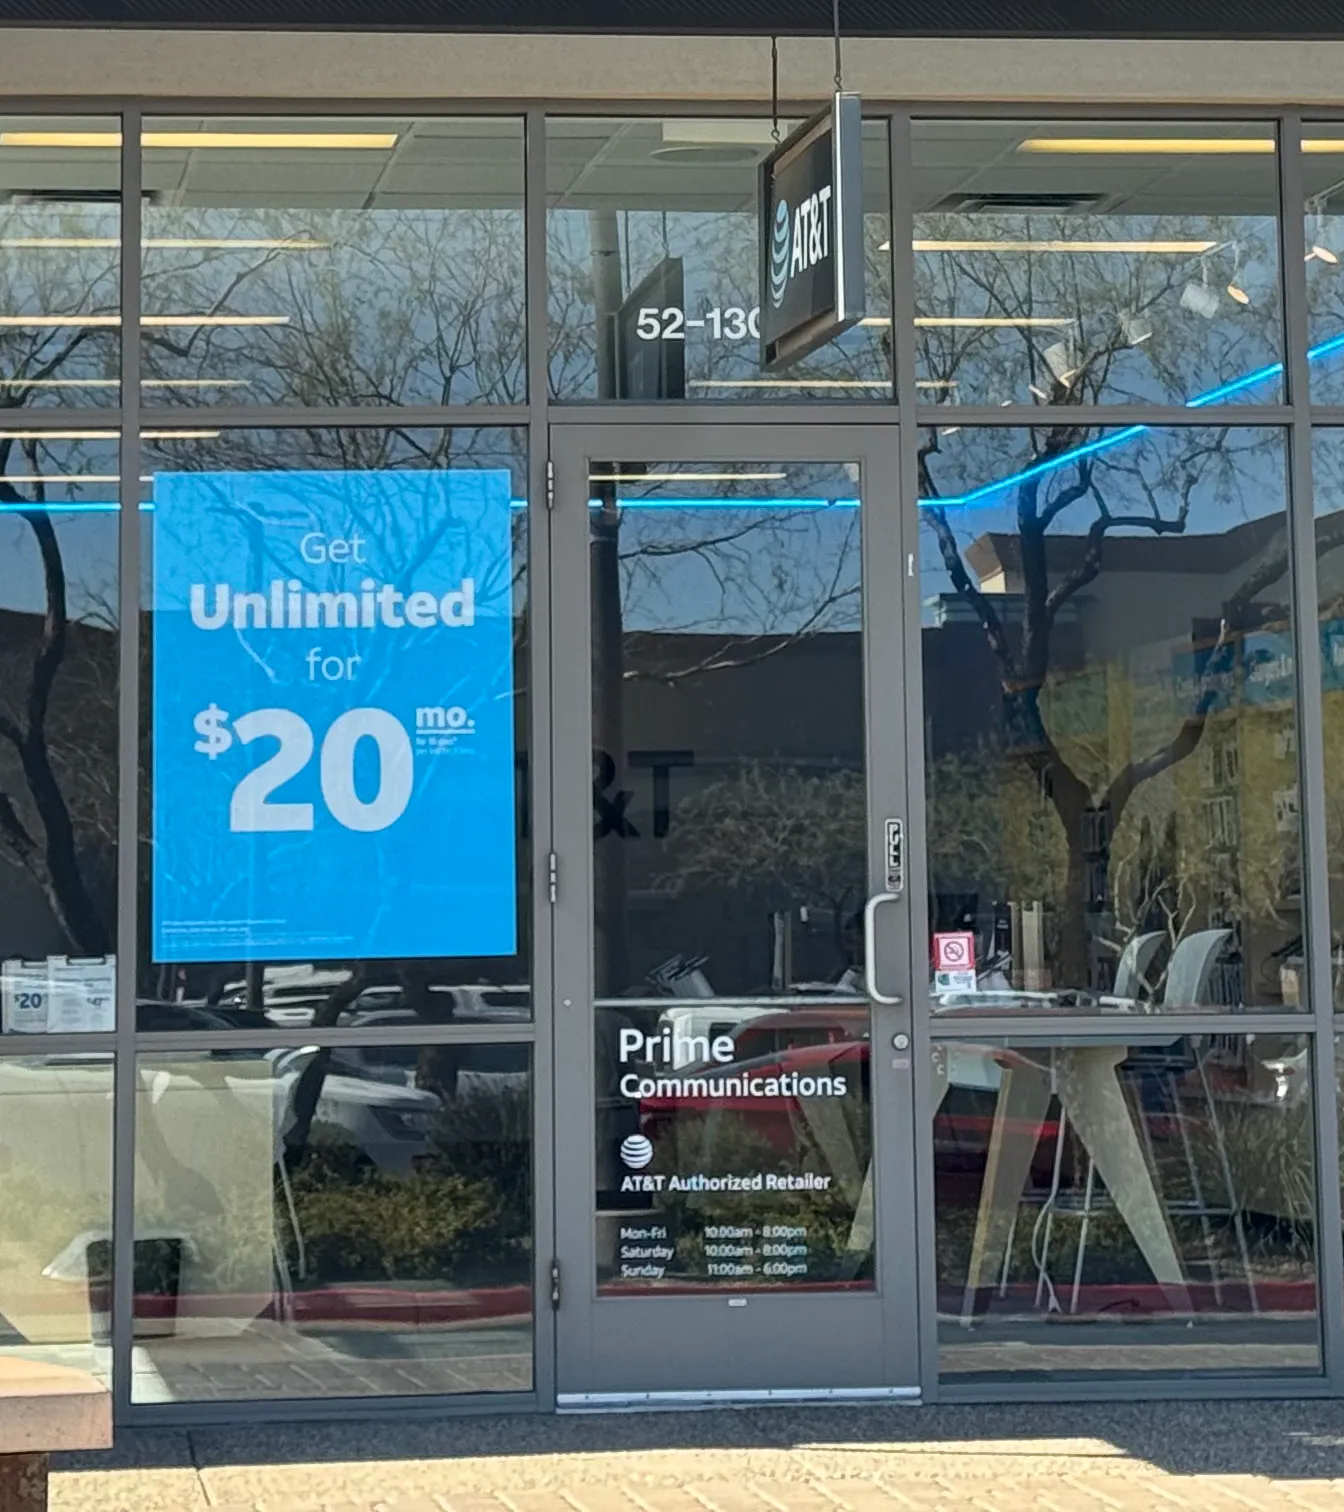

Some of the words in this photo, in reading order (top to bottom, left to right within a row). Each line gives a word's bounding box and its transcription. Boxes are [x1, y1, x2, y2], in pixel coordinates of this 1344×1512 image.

[790, 184, 832, 279] AT&T
[300, 532, 366, 565] Get
[190, 578, 476, 630] Unlimited
[305, 648, 362, 681] for
[194, 703, 414, 832] $20
[416, 706, 476, 727] mo.
[889, 823, 899, 867] PULL
[619, 1027, 735, 1063] Prime
[619, 1072, 847, 1097] Communications
[620, 1175, 665, 1192] AT&T
[668, 1173, 762, 1192] Authorized
[766, 1172, 832, 1190] Retailer
[620, 1225, 667, 1240] Mon-Fri
[620, 1244, 675, 1261] Saturday
[620, 1263, 666, 1279] Sunday
